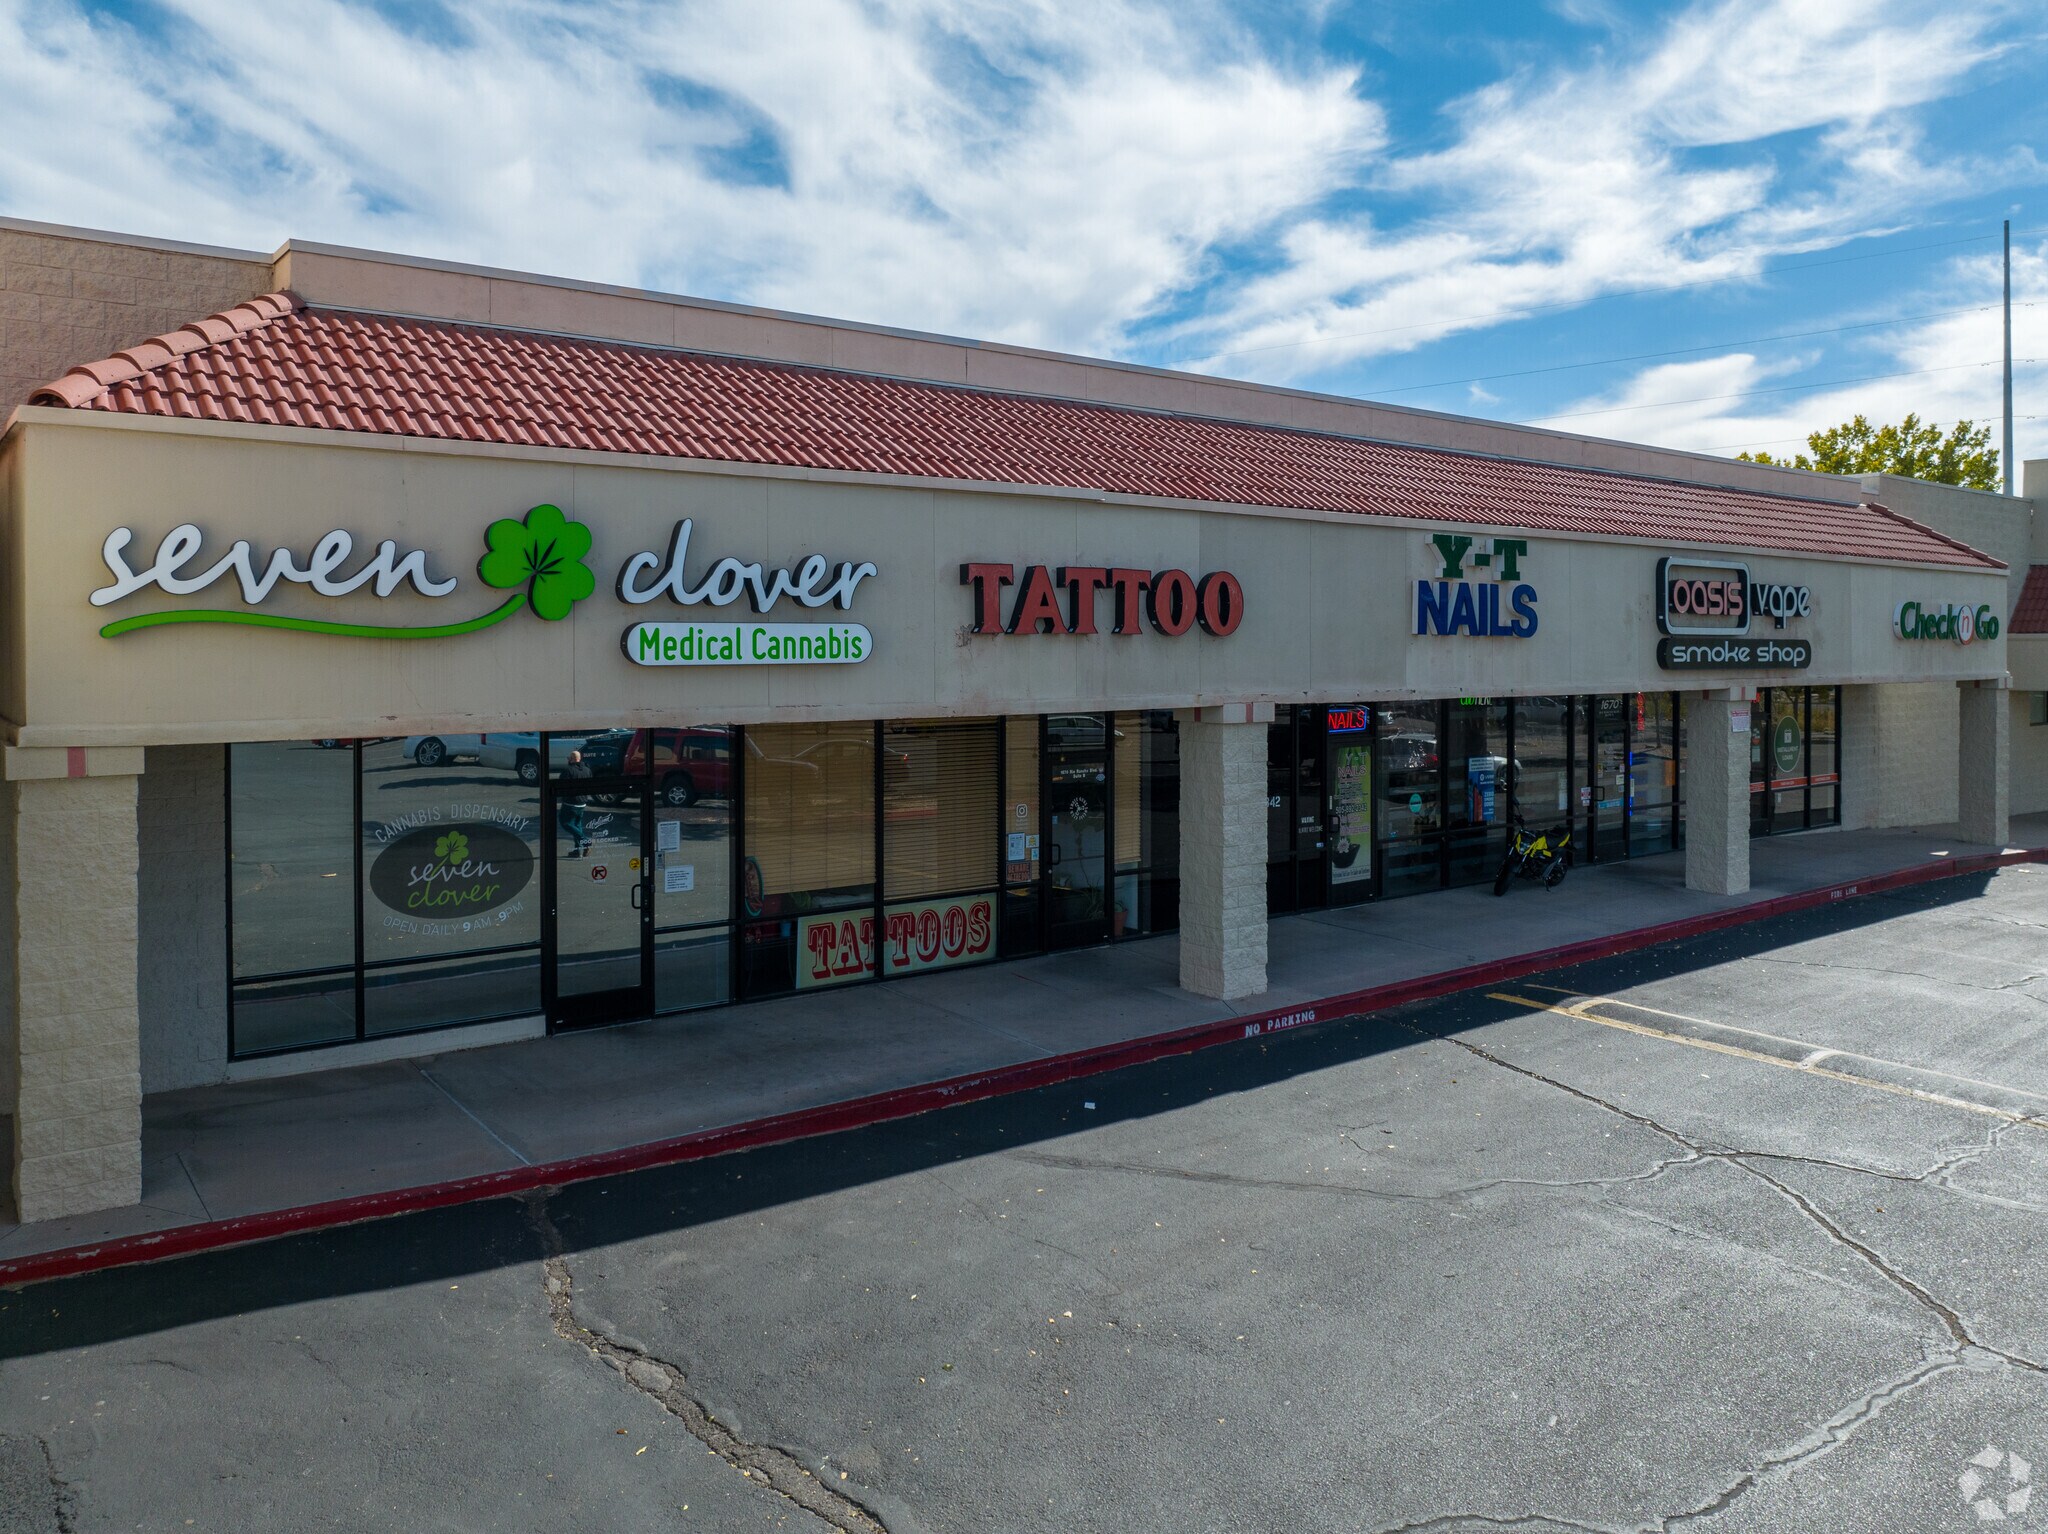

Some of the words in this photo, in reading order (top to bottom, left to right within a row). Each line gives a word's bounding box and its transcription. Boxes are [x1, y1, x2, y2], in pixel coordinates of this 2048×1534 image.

[89, 523, 457, 606] seven
[616, 518, 879, 614] clover
[1428, 534, 1528, 581] Y-T
[961, 562, 1245, 638] TATTOO
[1414, 580, 1539, 639] NAILS
[1755, 583, 1812, 630] vape
[1898, 601, 1958, 641] Check
[1975, 604, 2000, 640] Go
[638, 626, 743, 662] Medical
[751, 627, 863, 661] Cannabis
[1671, 640, 1751, 663] smoke
[1756, 641, 1806, 668] shop
[1327, 709, 1366, 730] NAILS
[375, 806, 441, 843] CANNABIS
[450, 803, 529, 832] DISPENSARY
[407, 860, 500, 887] seven
[407, 882, 500, 909] clover
[383, 916, 418, 934] OPEN
[422, 923, 459, 936] DAILY
[807, 900, 992, 980] TATTOOS
[1244, 1022, 1261, 1039] NO
[1267, 1009, 1316, 1031] PARKING
